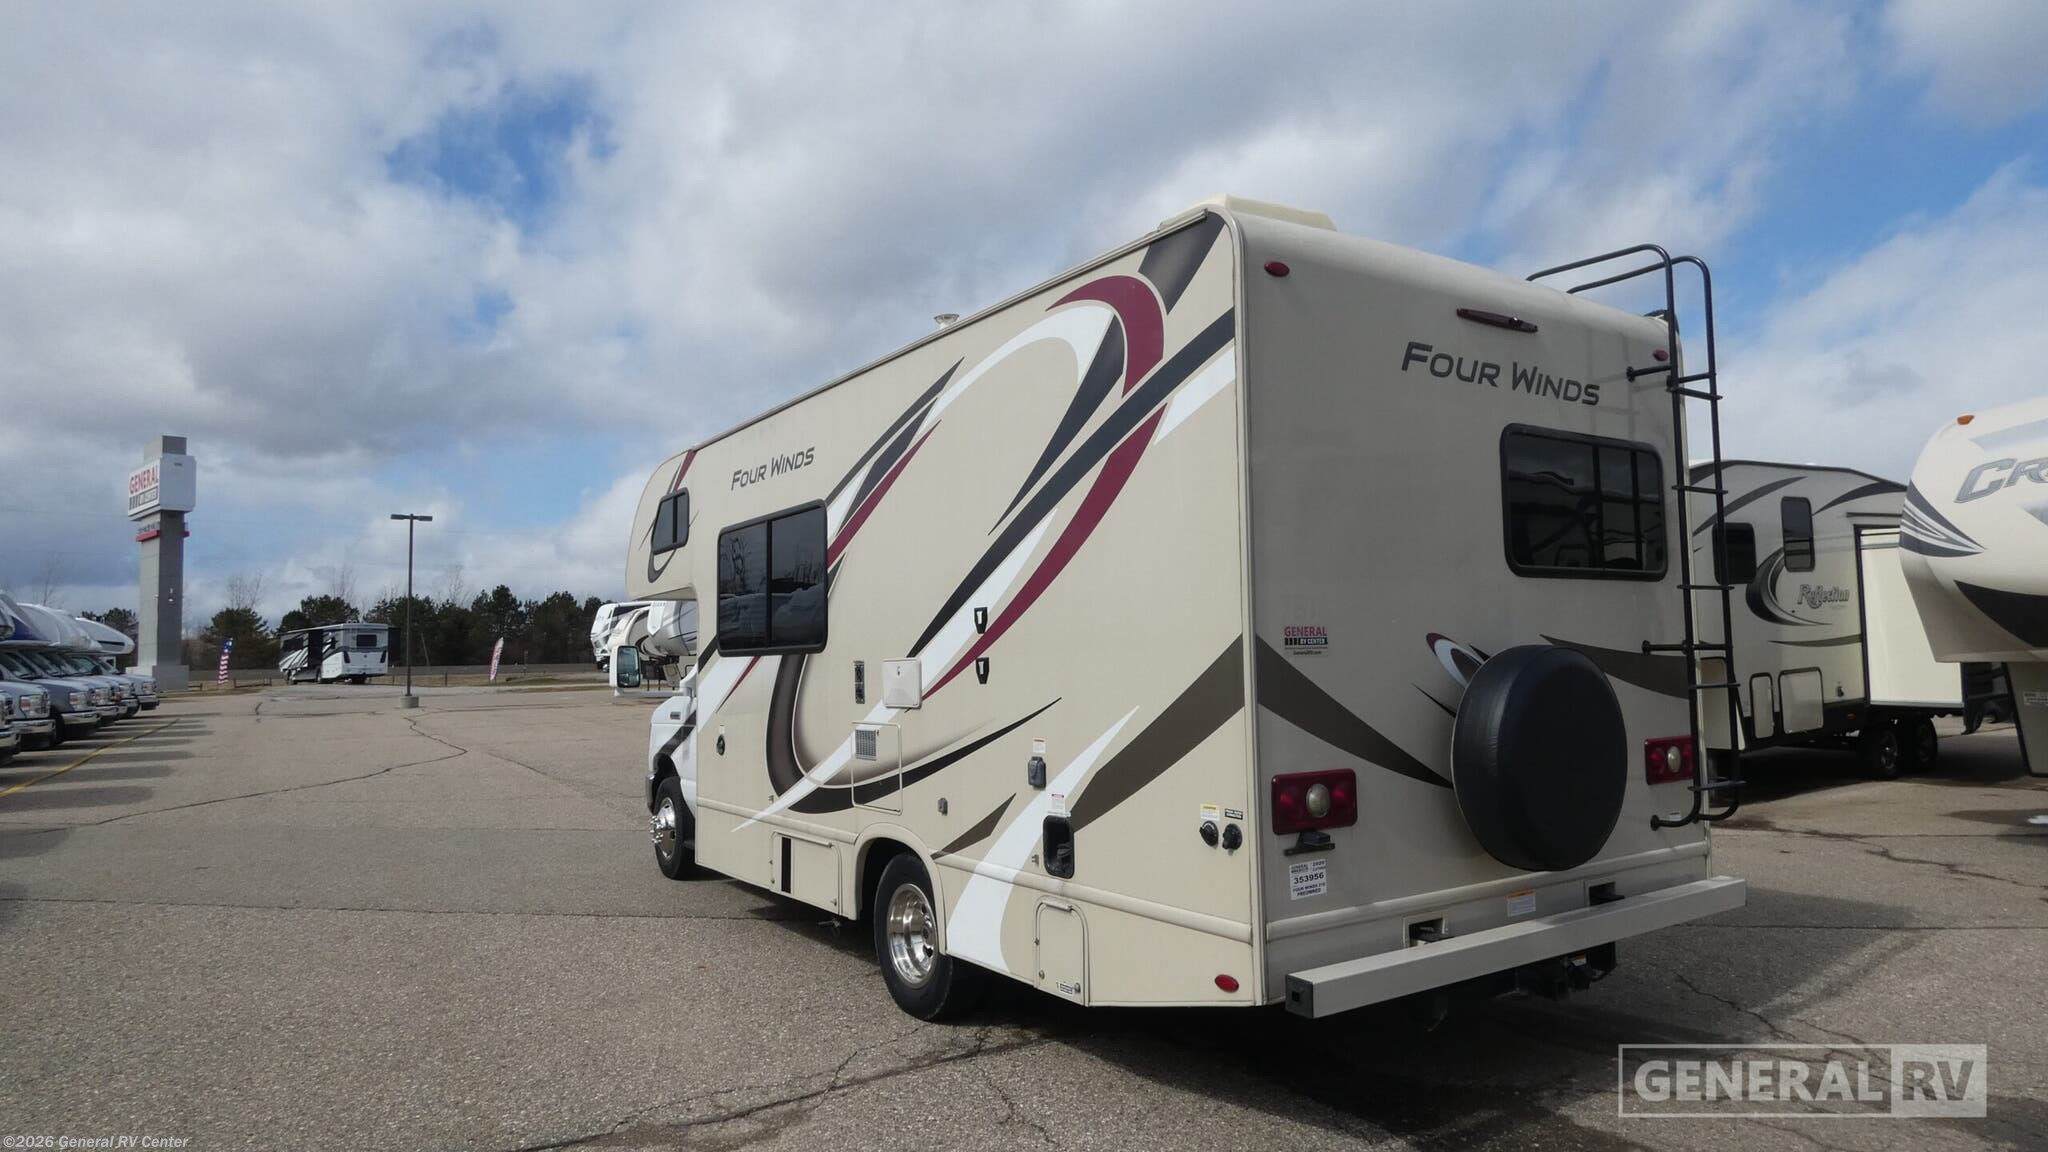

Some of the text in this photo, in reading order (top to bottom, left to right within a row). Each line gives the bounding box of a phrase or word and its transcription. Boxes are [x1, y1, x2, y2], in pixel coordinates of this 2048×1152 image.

[1401, 341, 1601, 406] FOUR WINDS
[129, 465, 159, 495] GENERAL
[730, 446, 815, 491] FOUR WINDS
[1797, 584, 1851, 609] Reflection
[1284, 626, 1328, 637] GENERAL
[1294, 872, 1325, 884] 353956
